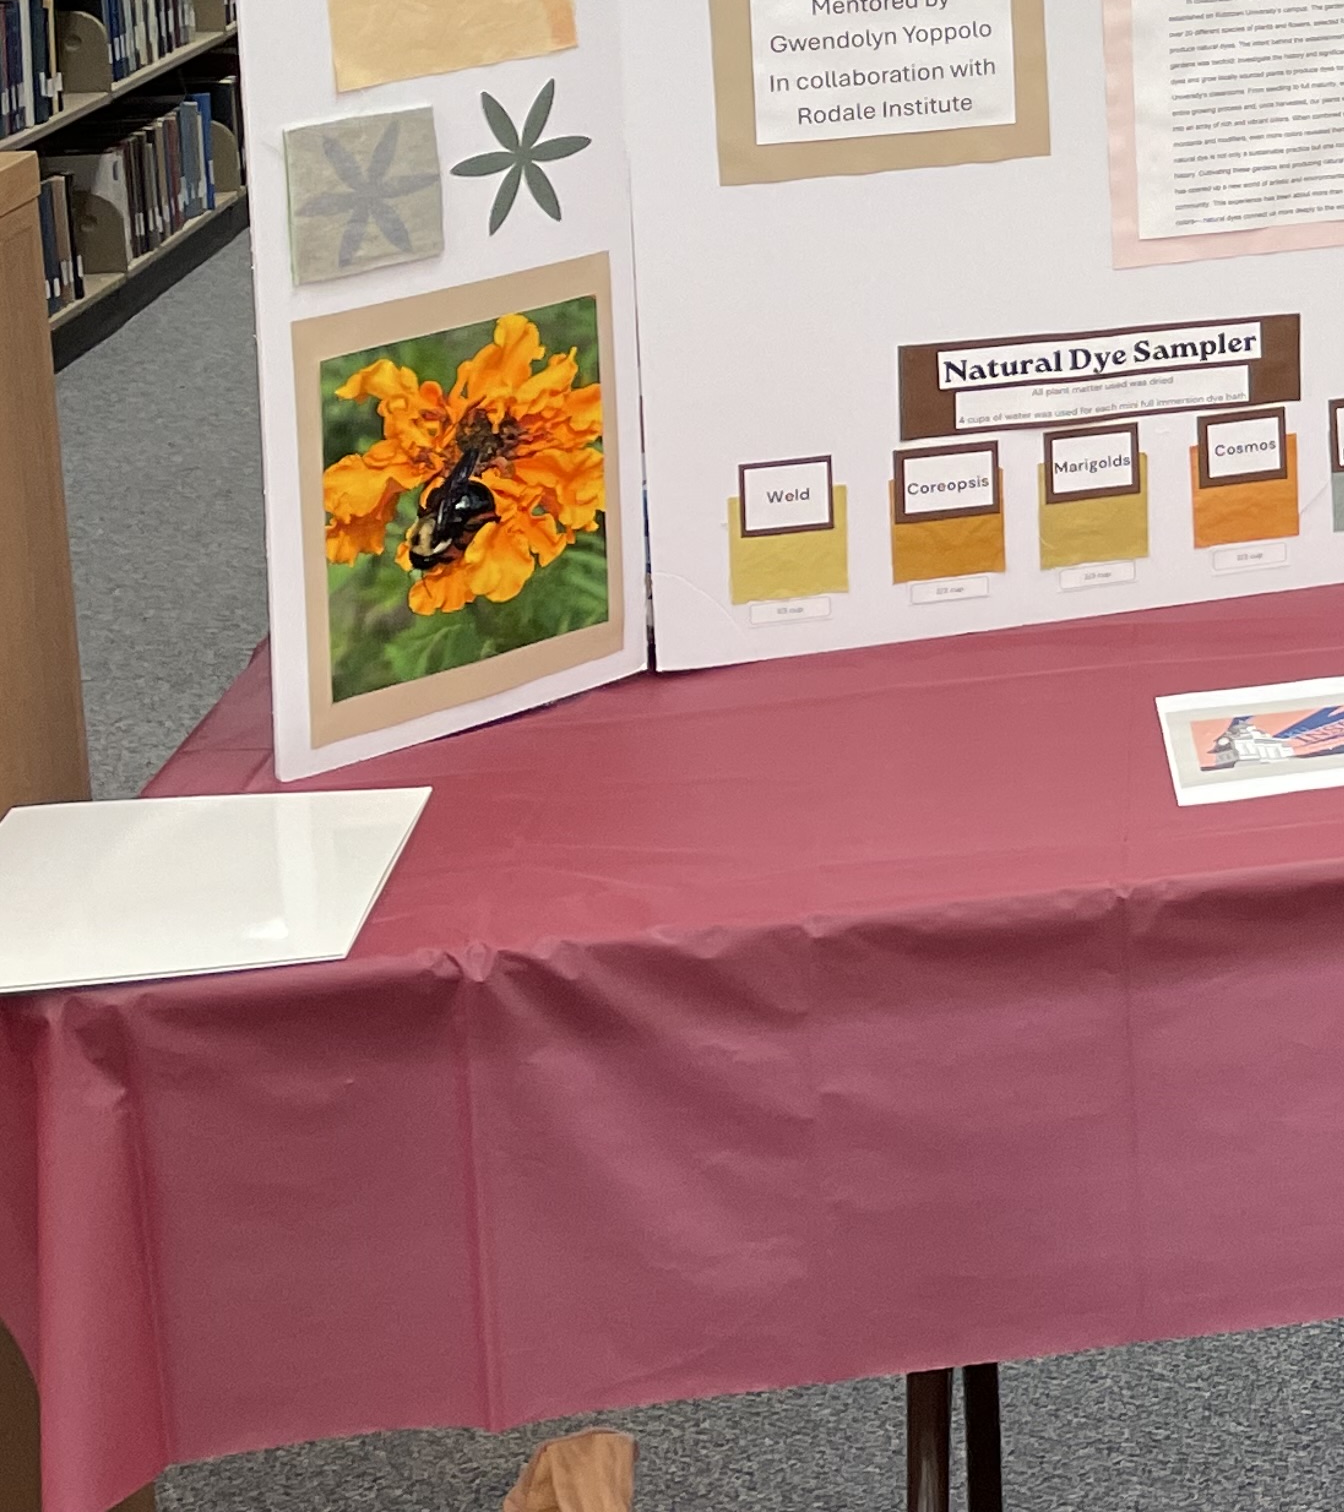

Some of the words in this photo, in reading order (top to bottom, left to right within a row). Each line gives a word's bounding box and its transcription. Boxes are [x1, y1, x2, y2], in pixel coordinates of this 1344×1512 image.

[770, 28, 897, 53] Gwendolyn
[902, 21, 992, 46] Yoppolo
[770, 74, 789, 92] In
[796, 63, 944, 90] collaboration
[950, 58, 996, 78] with
[798, 101, 876, 125] Rodale
[883, 96, 973, 118] Institute
[944, 349, 1063, 383] Natural
[1069, 347, 1126, 374] Dye
[1134, 332, 1256, 363] Sampler
[1032, 388, 1044, 396] All
[1046, 387, 1070, 397] plant
[1072, 384, 1103, 395] matter
[1105, 380, 1127, 391] used
[1129, 380, 1147, 388] was
[1149, 376, 1173, 386] dried
[959, 416, 965, 424] 4
[967, 415, 990, 425] cups
[993, 413, 1003, 421] of
[1005, 411, 1031, 420] water
[1034, 410, 1051, 418] was
[1054, 407, 1077, 417] used
[1080, 405, 1093, 415] for
[1095, 403, 1117, 413] each
[1119, 401, 1138, 410] mini
[1140, 399, 1154, 408] full
[1156, 396, 1204, 407] immersion
[1215, 440, 1276, 457] Cosmos
[1054, 455, 1130, 474] Marigolds
[768, 488, 810, 503] Weld
[907, 476, 989, 495] Coreopsis
